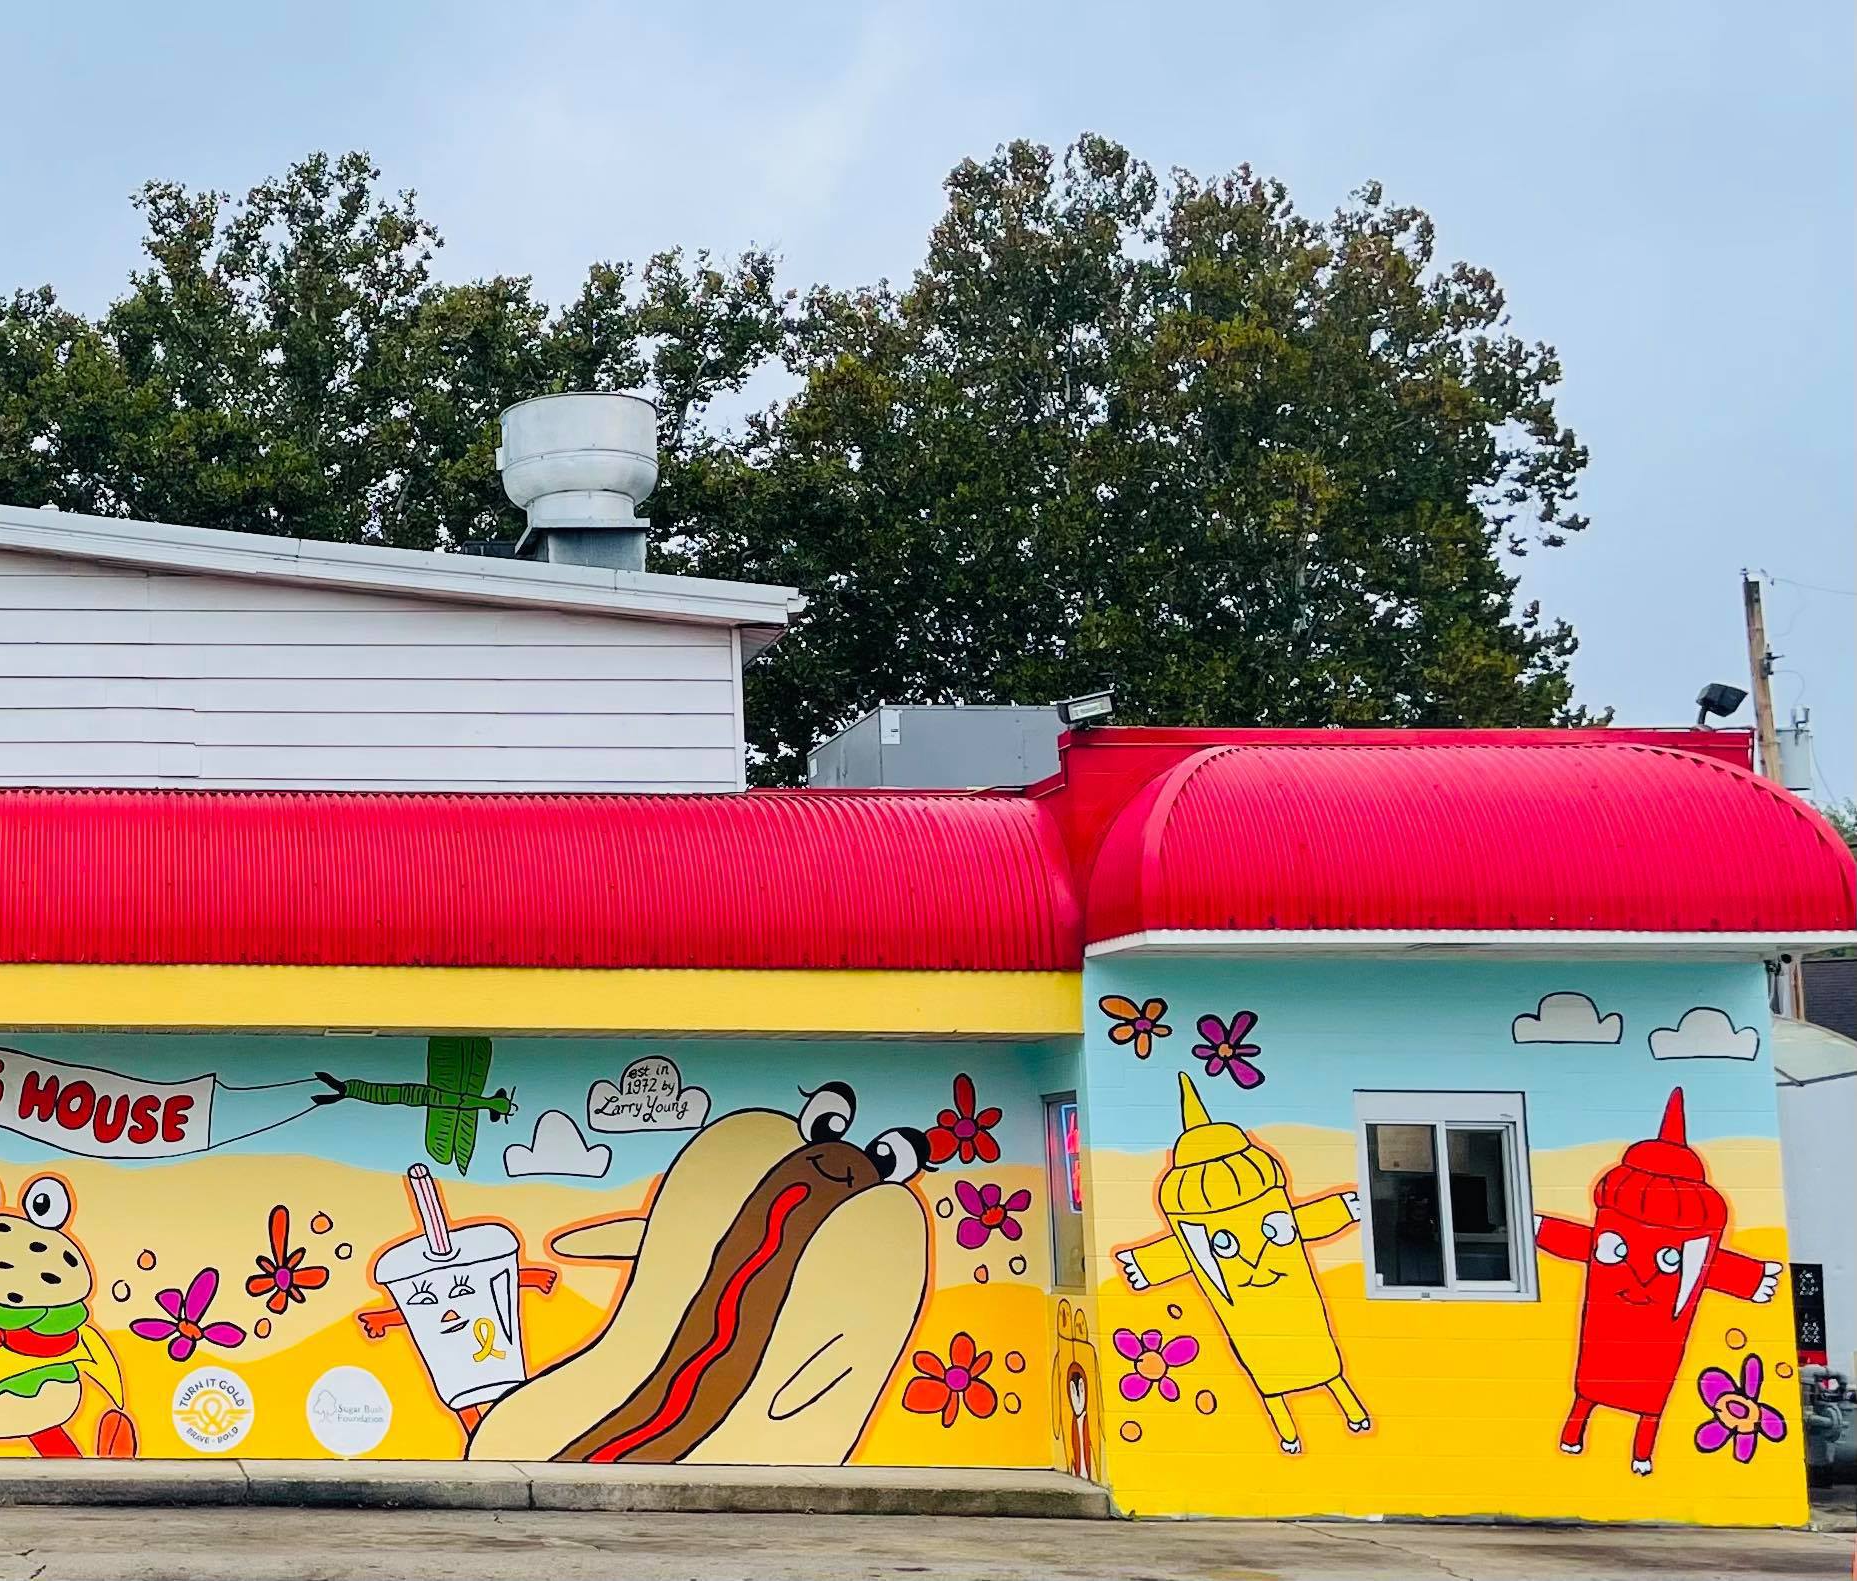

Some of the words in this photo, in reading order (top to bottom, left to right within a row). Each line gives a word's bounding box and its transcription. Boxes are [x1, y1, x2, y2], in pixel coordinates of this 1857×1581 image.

[656, 1064, 669, 1075] in
[625, 1078, 658, 1095] 1972
[661, 1081, 675, 1096] by
[17, 1071, 195, 1144] HOUSE
[594, 1095, 642, 1117] Larry
[642, 1095, 689, 1123] Young
[179, 1380, 204, 1407] TURN
[206, 1378, 216, 1388] IT
[219, 1380, 245, 1407] GOLD
[186, 1427, 210, 1444] BRAVE
[217, 1426, 239, 1443] BOLD
